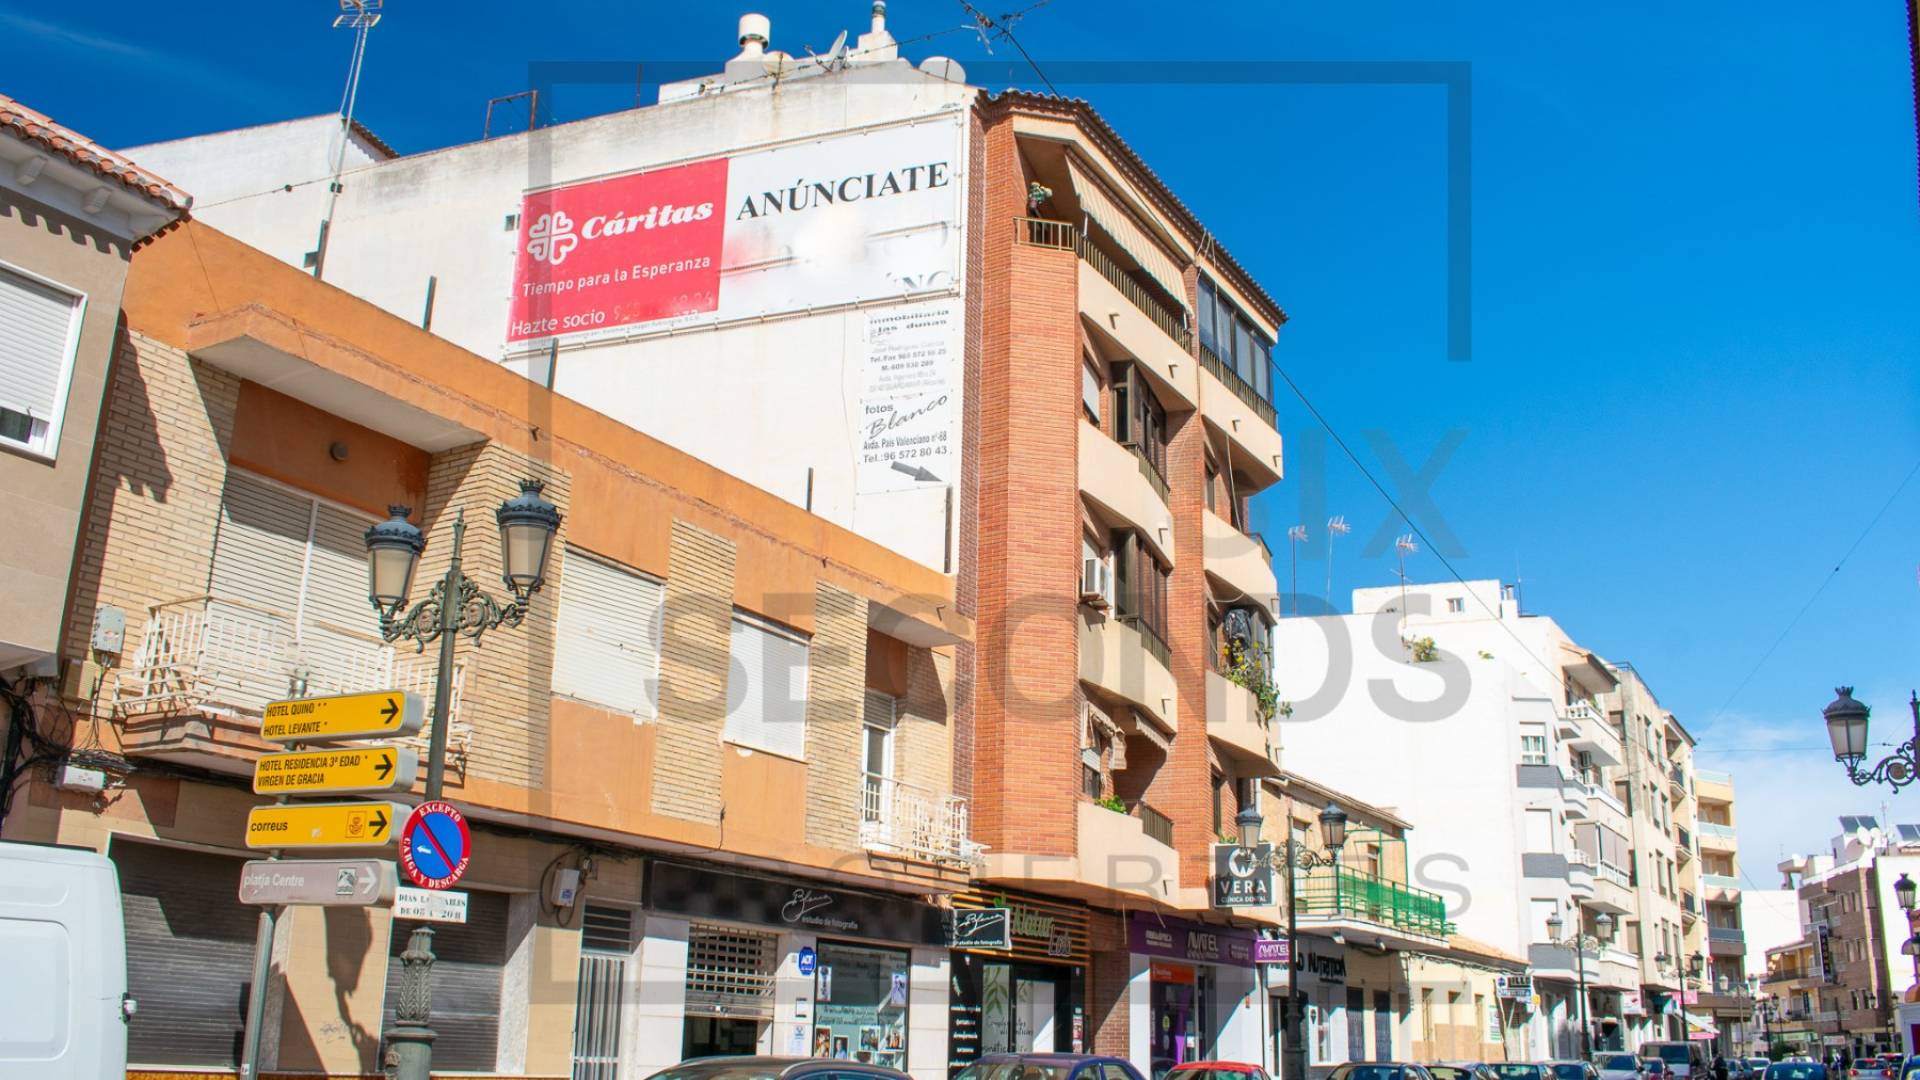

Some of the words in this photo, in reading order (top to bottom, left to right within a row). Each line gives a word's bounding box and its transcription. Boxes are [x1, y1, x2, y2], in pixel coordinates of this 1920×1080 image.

[736, 161, 949, 221] ANÚNCIATE
[581, 201, 714, 240] Cáritas
[522, 280, 574, 297] Tiempo
[577, 272, 611, 290] para
[614, 268, 628, 282] la
[632, 255, 711, 280] Esperanza
[510, 318, 558, 337] Hazte
[562, 308, 606, 330] socio
[865, 404, 894, 415] fotos
[866, 395, 948, 439] Blanco
[898, 448, 918, 460] 572
[919, 446, 933, 457] 80
[934, 445, 948, 456] 43
[266, 705, 289, 717] HOTEL
[291, 702, 315, 715] QUINO
[263, 724, 286, 736] HOTEL
[288, 721, 321, 734] LEVANTE
[259, 760, 282, 771] HOTEL
[284, 756, 328, 770] RESIDENCIA
[340, 755, 361, 767] EDAD
[258, 775, 285, 787] VIRGEN
[285, 774, 295, 785] DE
[297, 773, 325, 785] GRACIA
[418, 803, 462, 823] EXCEPTO
[250, 821, 288, 832] correus
[403, 837, 418, 877] CARGA
[420, 876, 427, 885] Y
[428, 857, 469, 889] DESCARGA
[243, 873, 271, 889] platja
[271, 873, 305, 887] Centre
[1220, 879, 1268, 895] VERA
[1187, 931, 1219, 953] AVATEL
[1258, 944, 1290, 957] AVATEL
[800, 954, 813, 964] ADT
